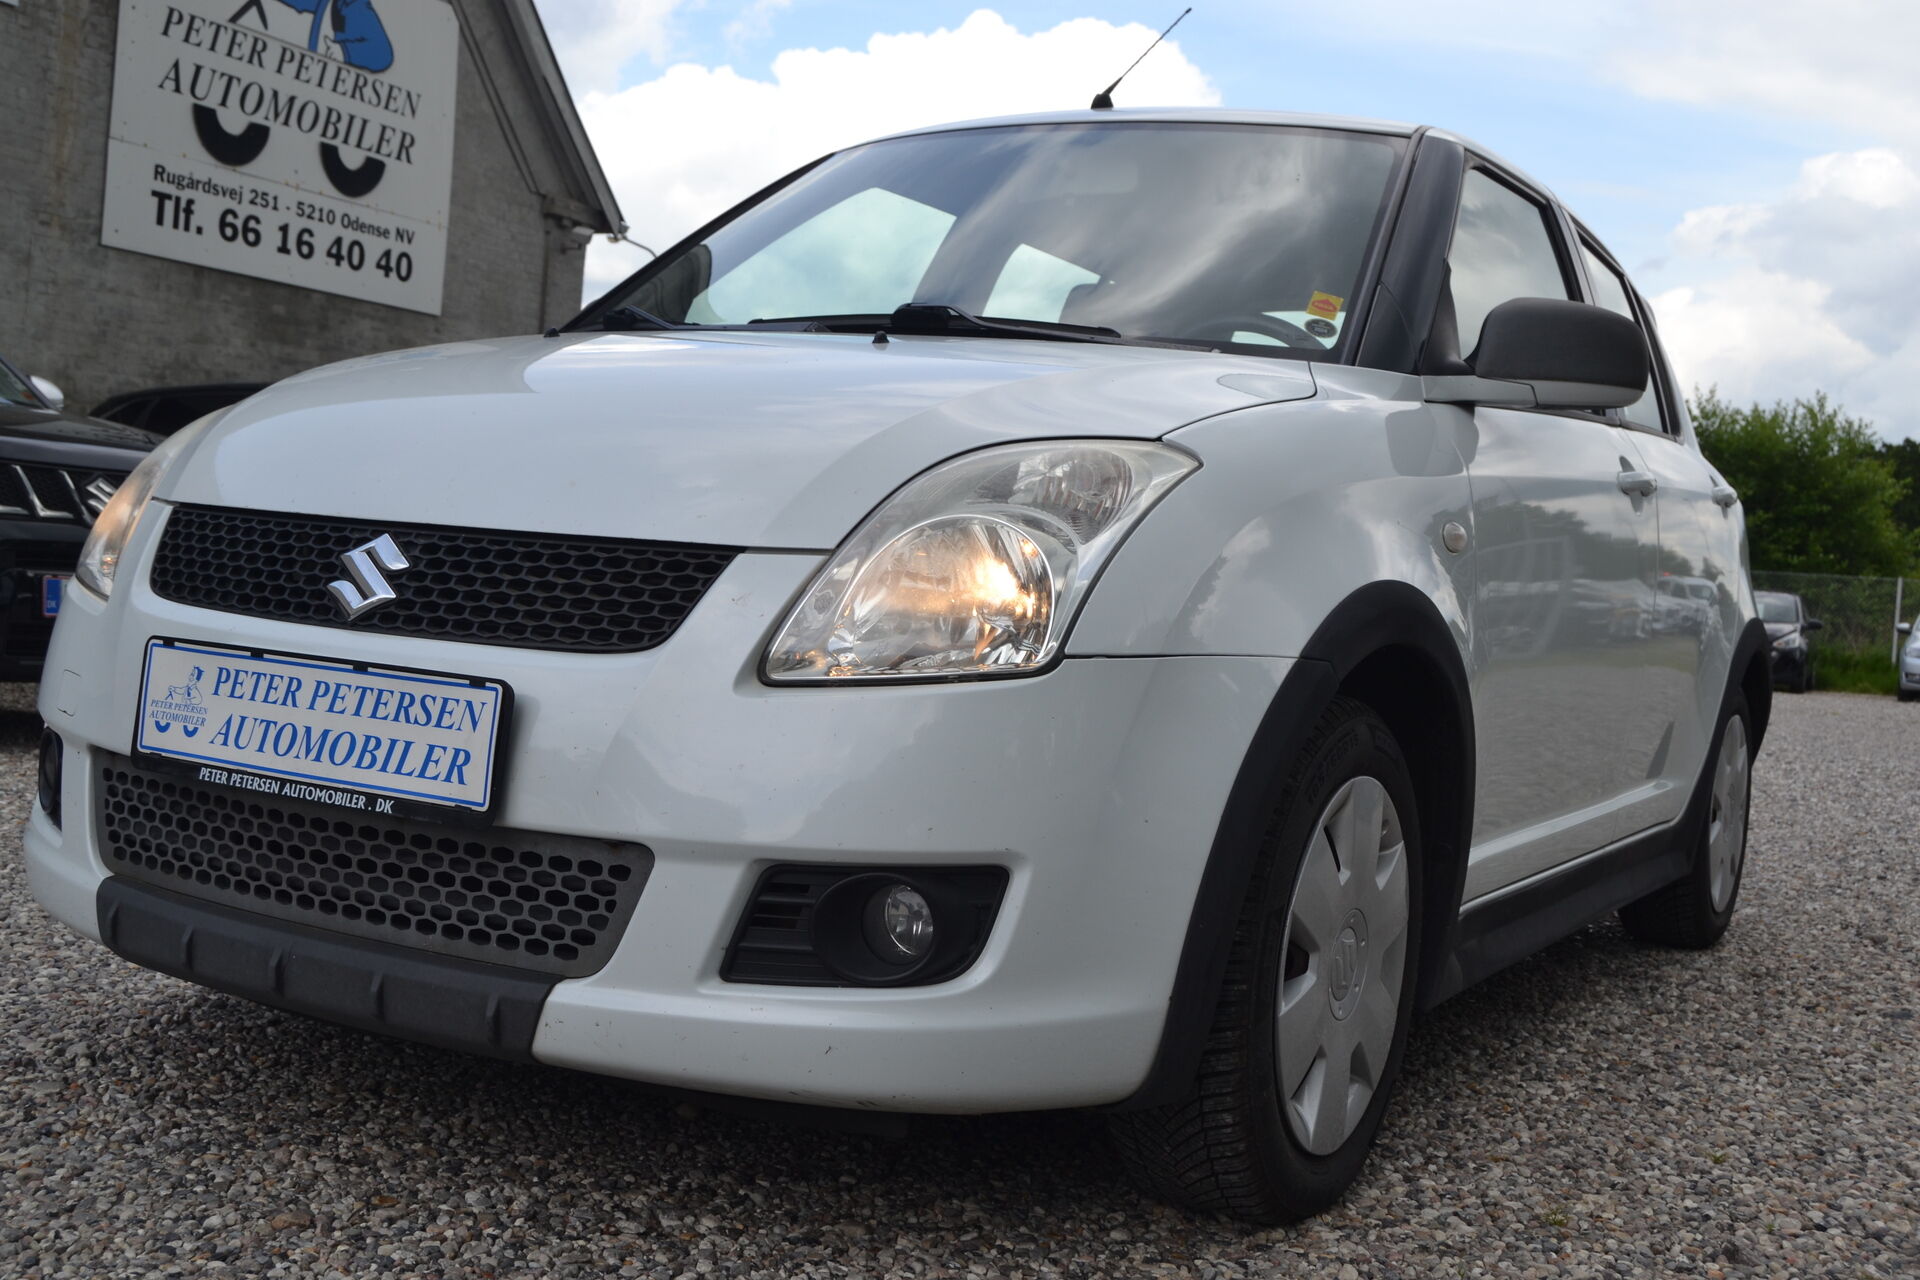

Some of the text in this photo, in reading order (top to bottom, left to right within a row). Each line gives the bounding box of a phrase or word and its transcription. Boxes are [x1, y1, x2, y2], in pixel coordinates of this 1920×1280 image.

[160, 6, 422, 120] PETER PETERSEN
[157, 57, 416, 165] AUTOMOBILER
[151, 190, 413, 283] Tlf. 66 16 40 40
[153, 164, 243, 205] Rugårdsvej
[249, 188, 279, 212] 251
[296, 202, 336, 225] 5210
[341, 215, 391, 240] Odense
[395, 228, 416, 245] NV
[149, 710, 207, 727] AUTOMOBILER
[150, 699, 209, 715] PETER PETERSEN
[211, 666, 488, 734] PETER PETERSEN
[208, 712, 473, 786] AUTOMOBILER
[199, 767, 228, 785] PETER
[230, 772, 281, 795] PETERSEN
[282, 782, 367, 810] AUTOMOBILER
